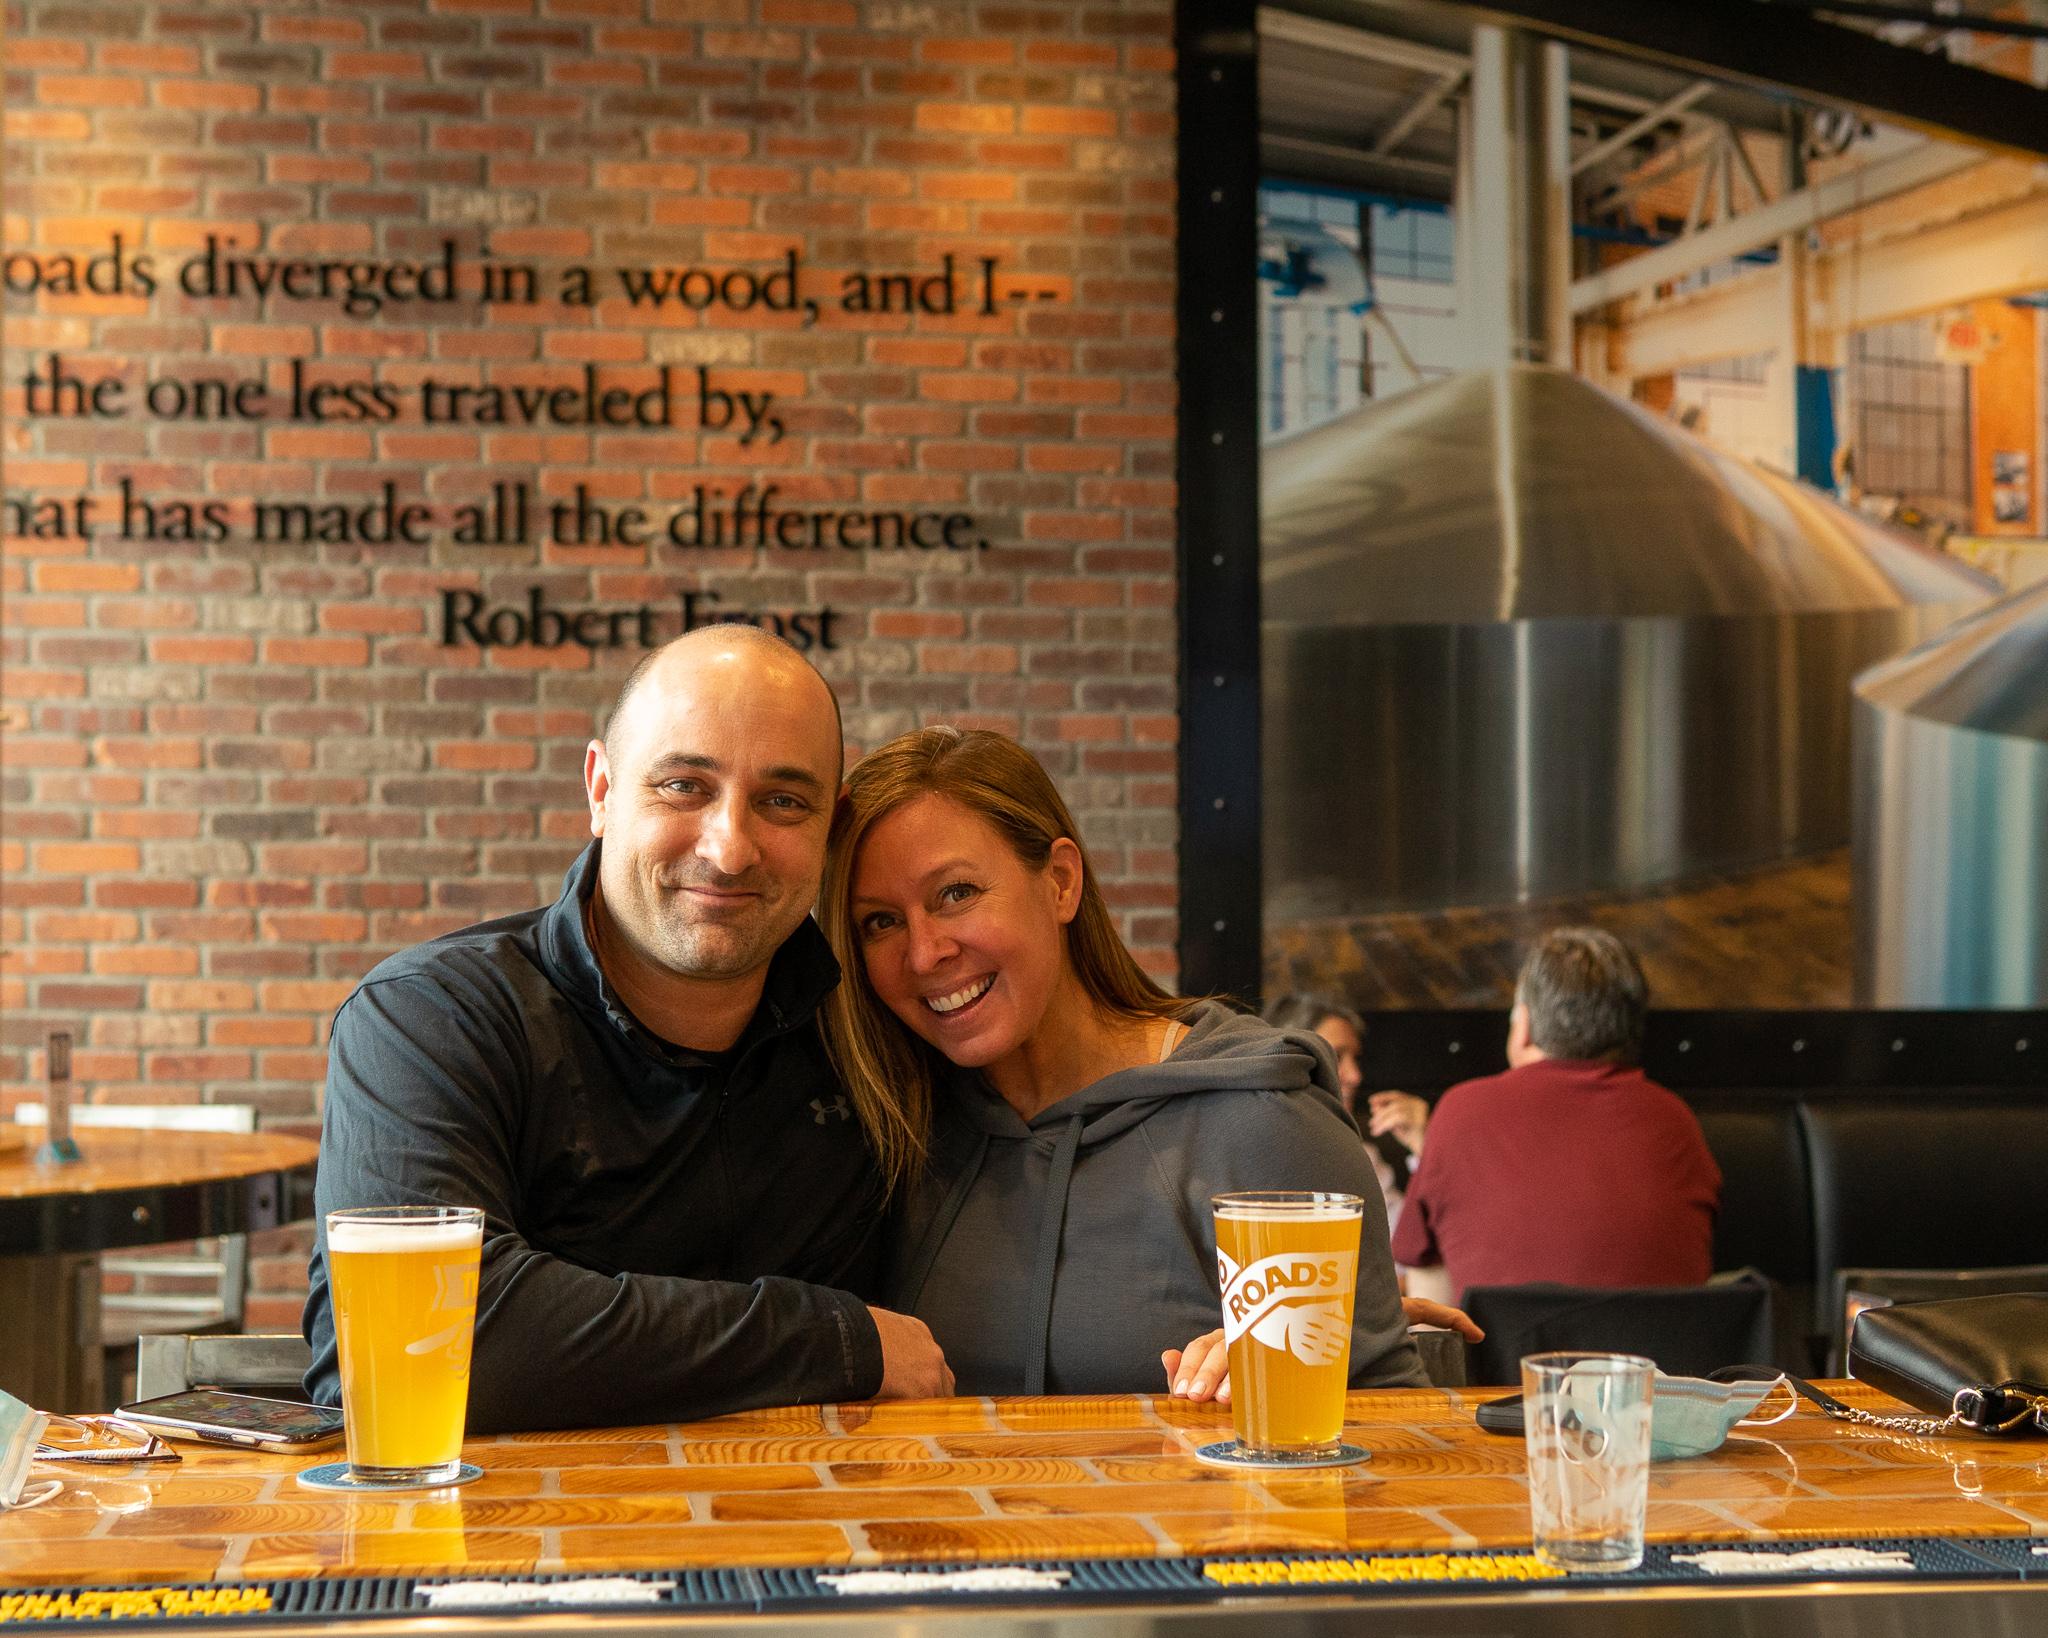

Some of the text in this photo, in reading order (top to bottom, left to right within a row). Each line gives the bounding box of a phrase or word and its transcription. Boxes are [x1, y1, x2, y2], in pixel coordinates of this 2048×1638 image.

[4, 233, 157, 297] oads
[180, 234, 457, 319] diverged
[480, 244, 537, 304] in
[560, 263, 596, 306] a
[619, 249, 820, 330] wood,
[840, 253, 957, 316] and
[24, 353, 785, 446] the one less traveled by,
[119, 478, 230, 543] has
[253, 482, 432, 545] made
[452, 482, 530, 545] all
[550, 484, 648, 547] the
[668, 484, 990, 551] difference.
[440, 586, 840, 651] Robert Fst
[1228, 1260, 1339, 1324] ROADS
